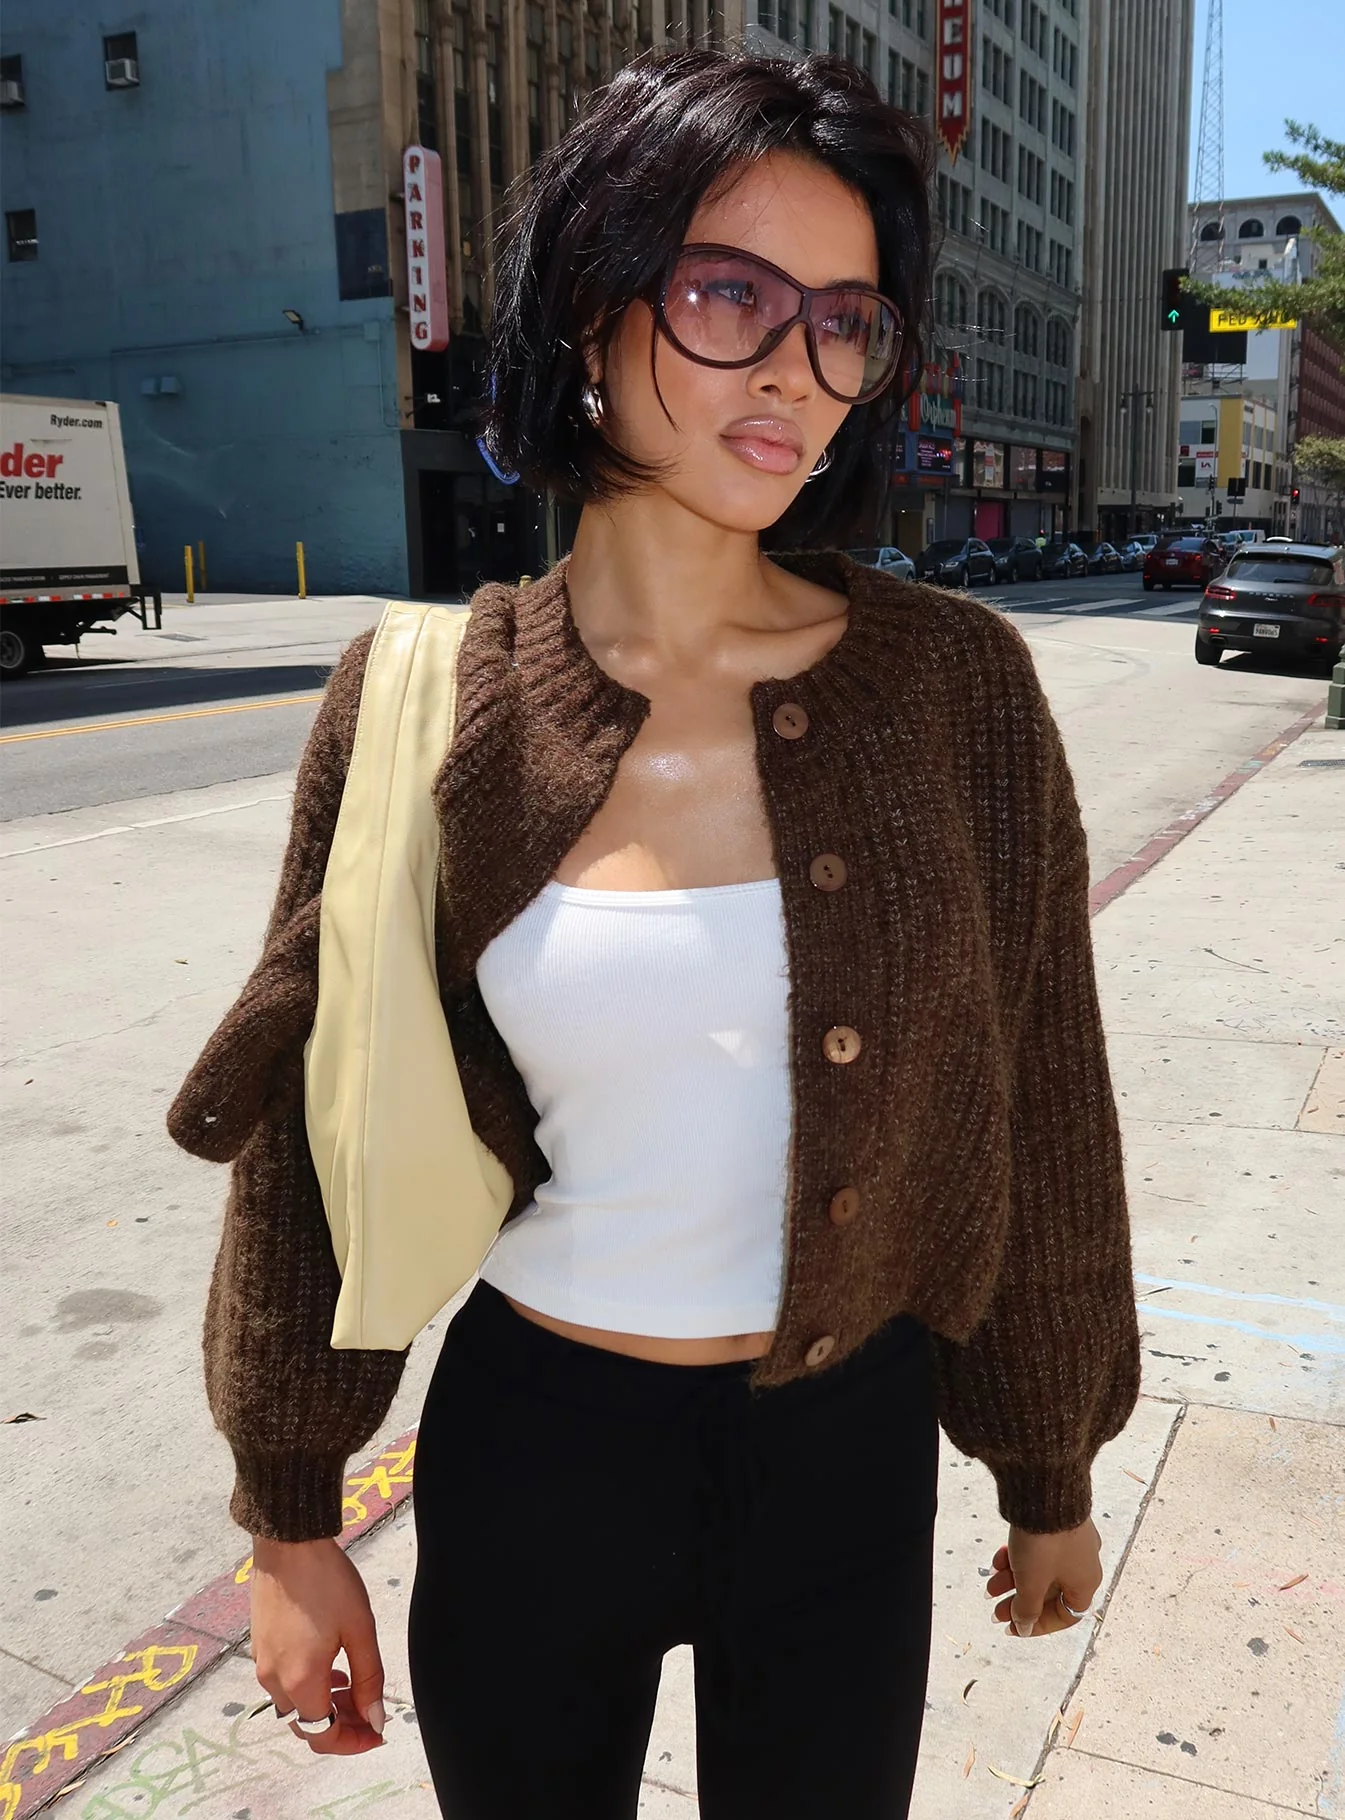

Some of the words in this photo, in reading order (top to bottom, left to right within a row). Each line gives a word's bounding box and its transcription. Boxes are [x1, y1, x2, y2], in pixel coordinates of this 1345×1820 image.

[408, 154, 428, 340] PARKING
[50, 414, 103, 429] Ryder.com
[35, 481, 82, 500] better.
